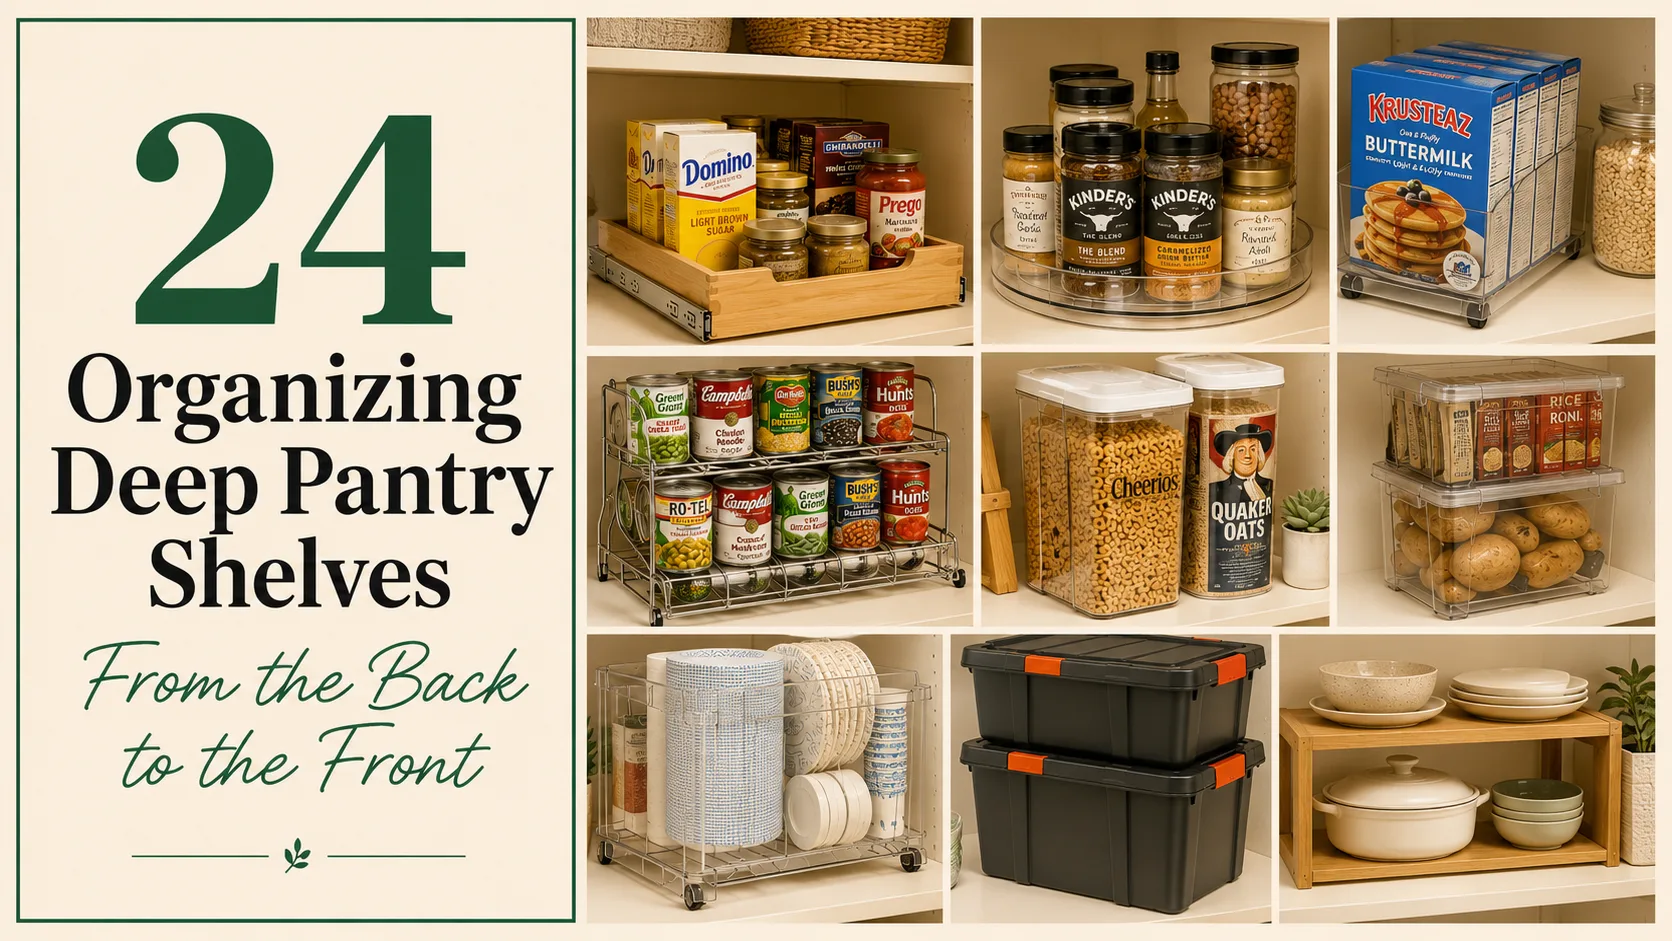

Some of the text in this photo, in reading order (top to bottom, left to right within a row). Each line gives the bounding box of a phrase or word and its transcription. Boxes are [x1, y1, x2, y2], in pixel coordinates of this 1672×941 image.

[1368, 92, 1474, 139] KRUSTEAZ
[1365, 135, 1473, 170] BUTTERMILK
[682, 152, 753, 187] Domino
[878, 196, 922, 217] Prego
[1068, 188, 1135, 211] KINDER'S
[1151, 188, 1217, 211] KINDER'S
[706, 226, 735, 236] SUGAR
[717, 213, 749, 226] BROWN
[1078, 246, 1126, 257] THE BLEND
[1550, 393, 1582, 408] RICE
[1111, 472, 1179, 500] Cheerios
[1211, 496, 1273, 524] QUAKER
[1224, 518, 1265, 542] OATS
